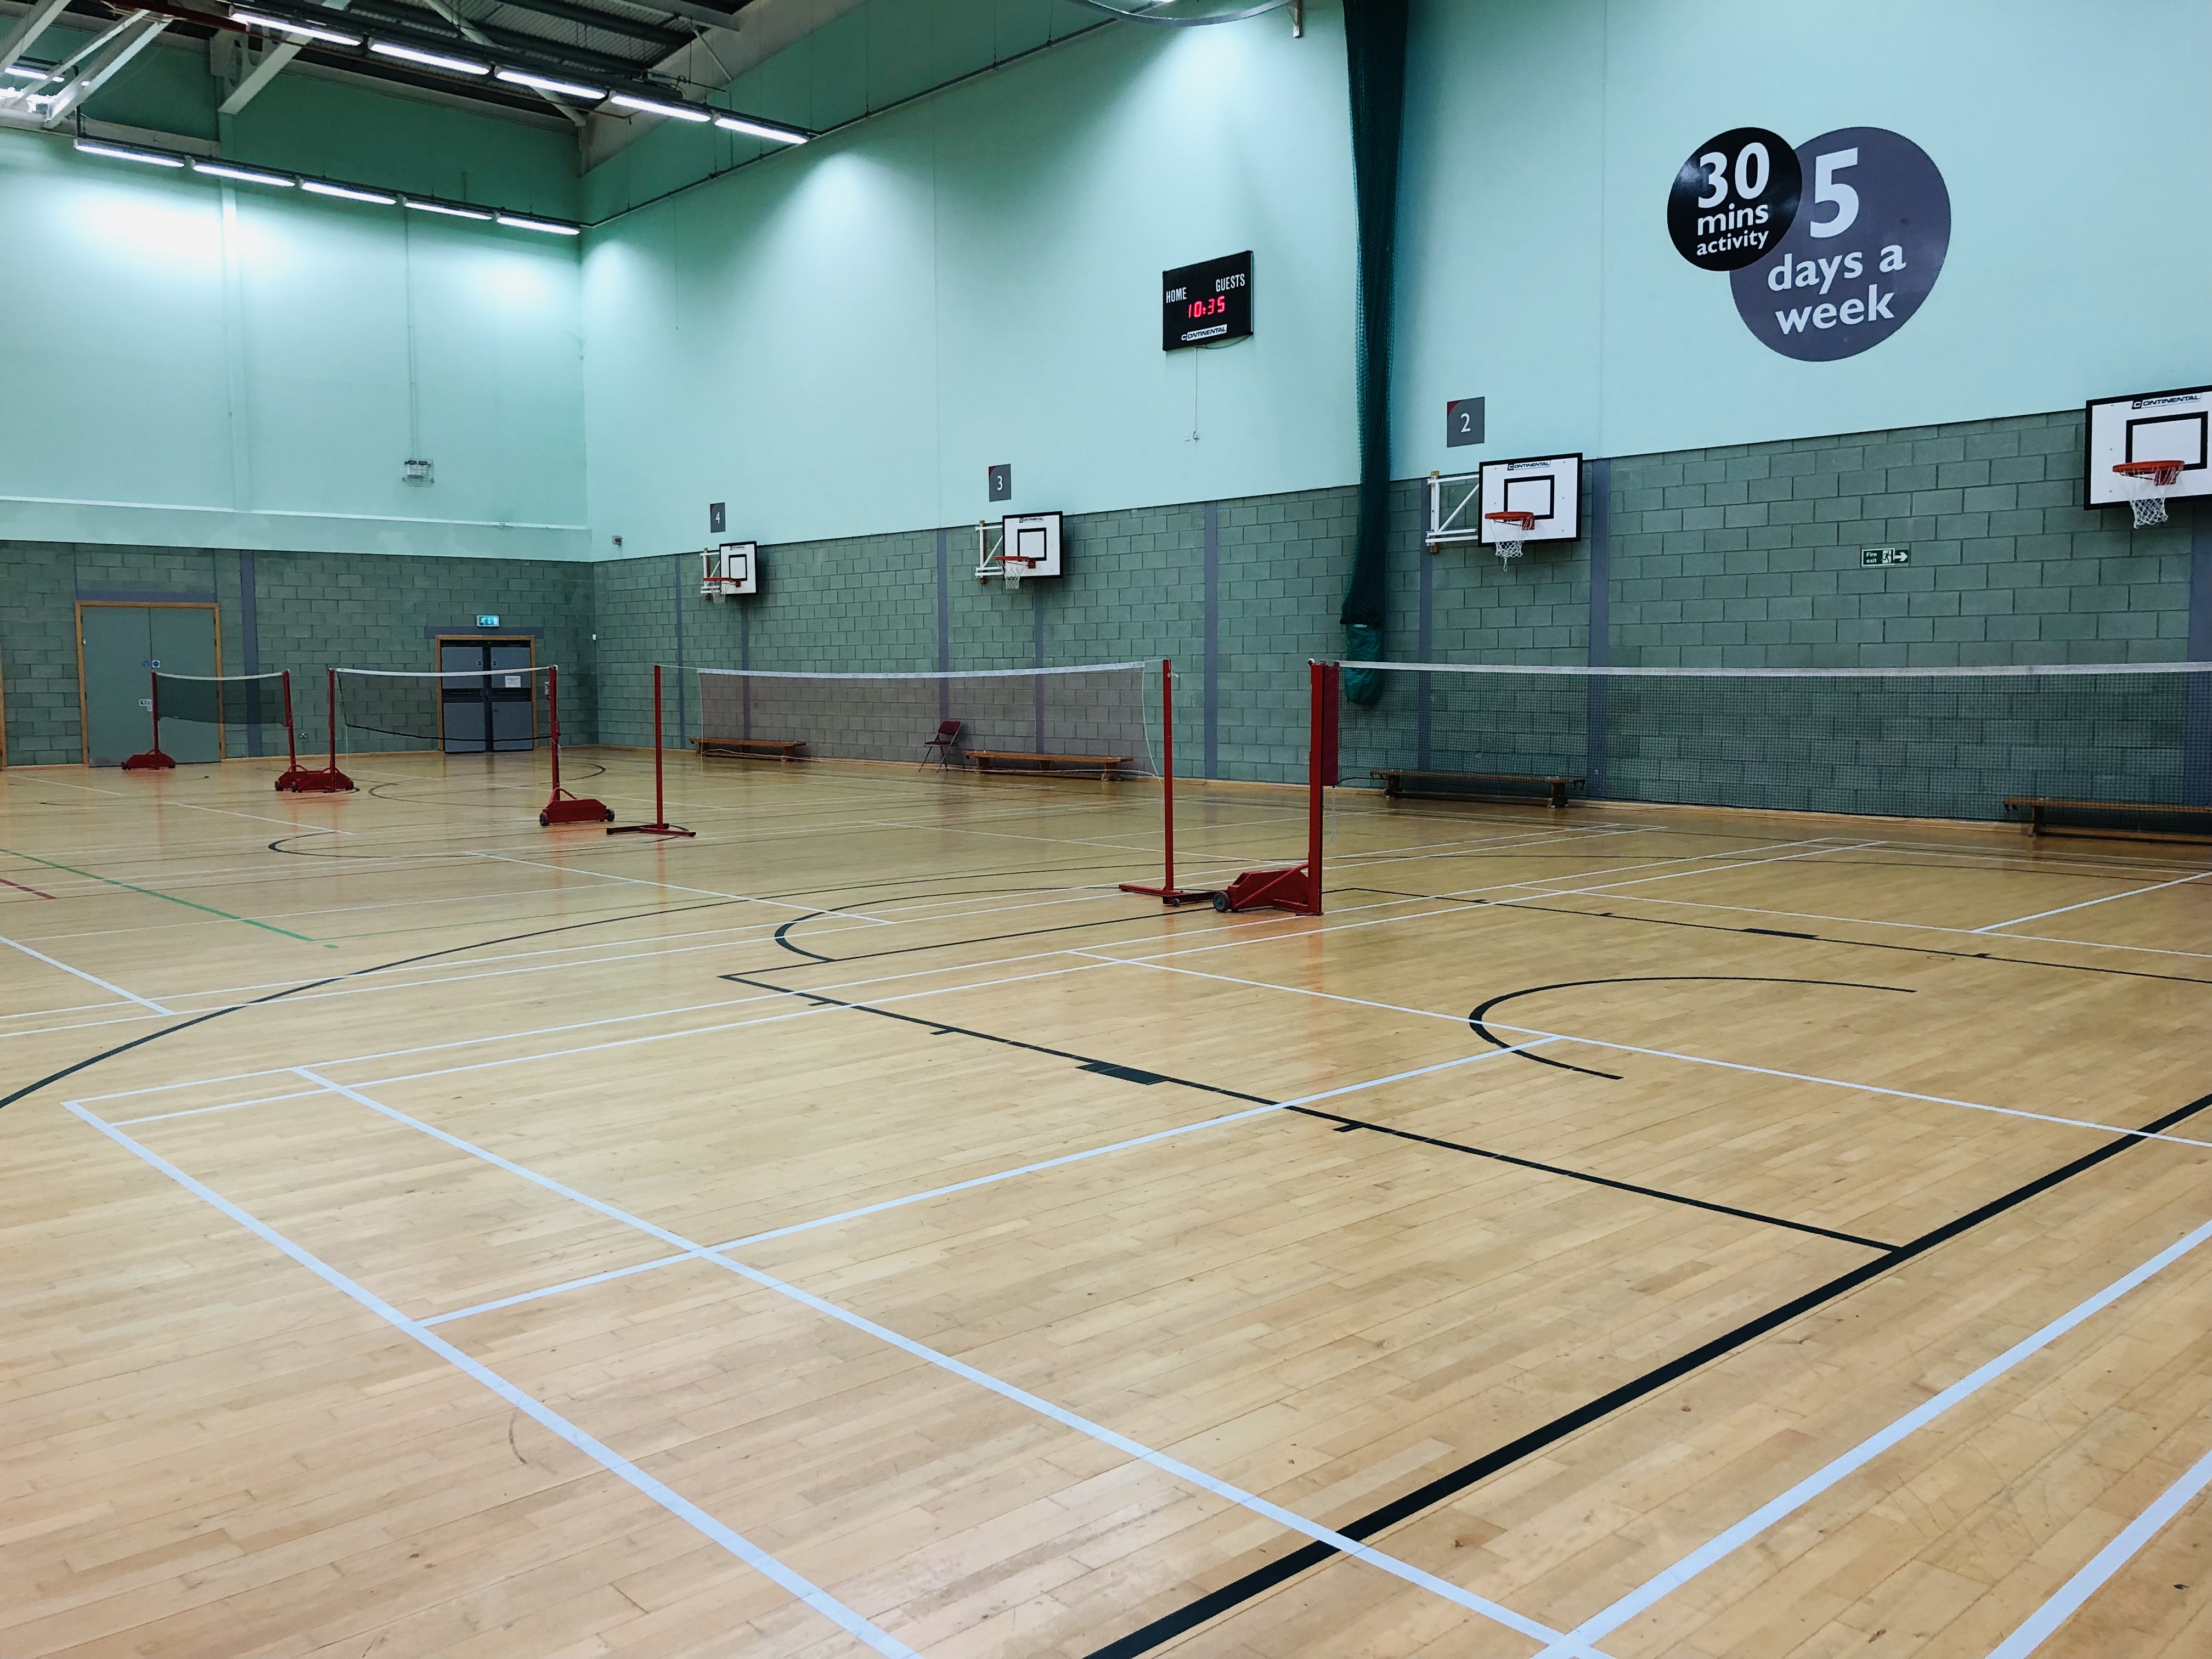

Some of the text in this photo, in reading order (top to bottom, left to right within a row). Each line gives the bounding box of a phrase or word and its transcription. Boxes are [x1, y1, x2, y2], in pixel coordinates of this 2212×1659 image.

[1698, 142, 1770, 208] 30
[1810, 147, 1859, 238] 5
[1697, 203, 1769, 236] mins
[1696, 229, 1769, 256] activity
[1768, 243, 1907, 295] days a
[1216, 273, 1245, 292] GUESTS
[1166, 287, 1187, 303] HOME
[1188, 295, 1226, 318] 10:35
[1774, 284, 1895, 335] week
[1181, 327, 1226, 341] CONTINENTAL
[2134, 395, 2199, 408] CONTINENTAL
[1460, 413, 1471, 433] 2
[997, 475, 1003, 491] 3
[715, 511, 720, 524] 4
